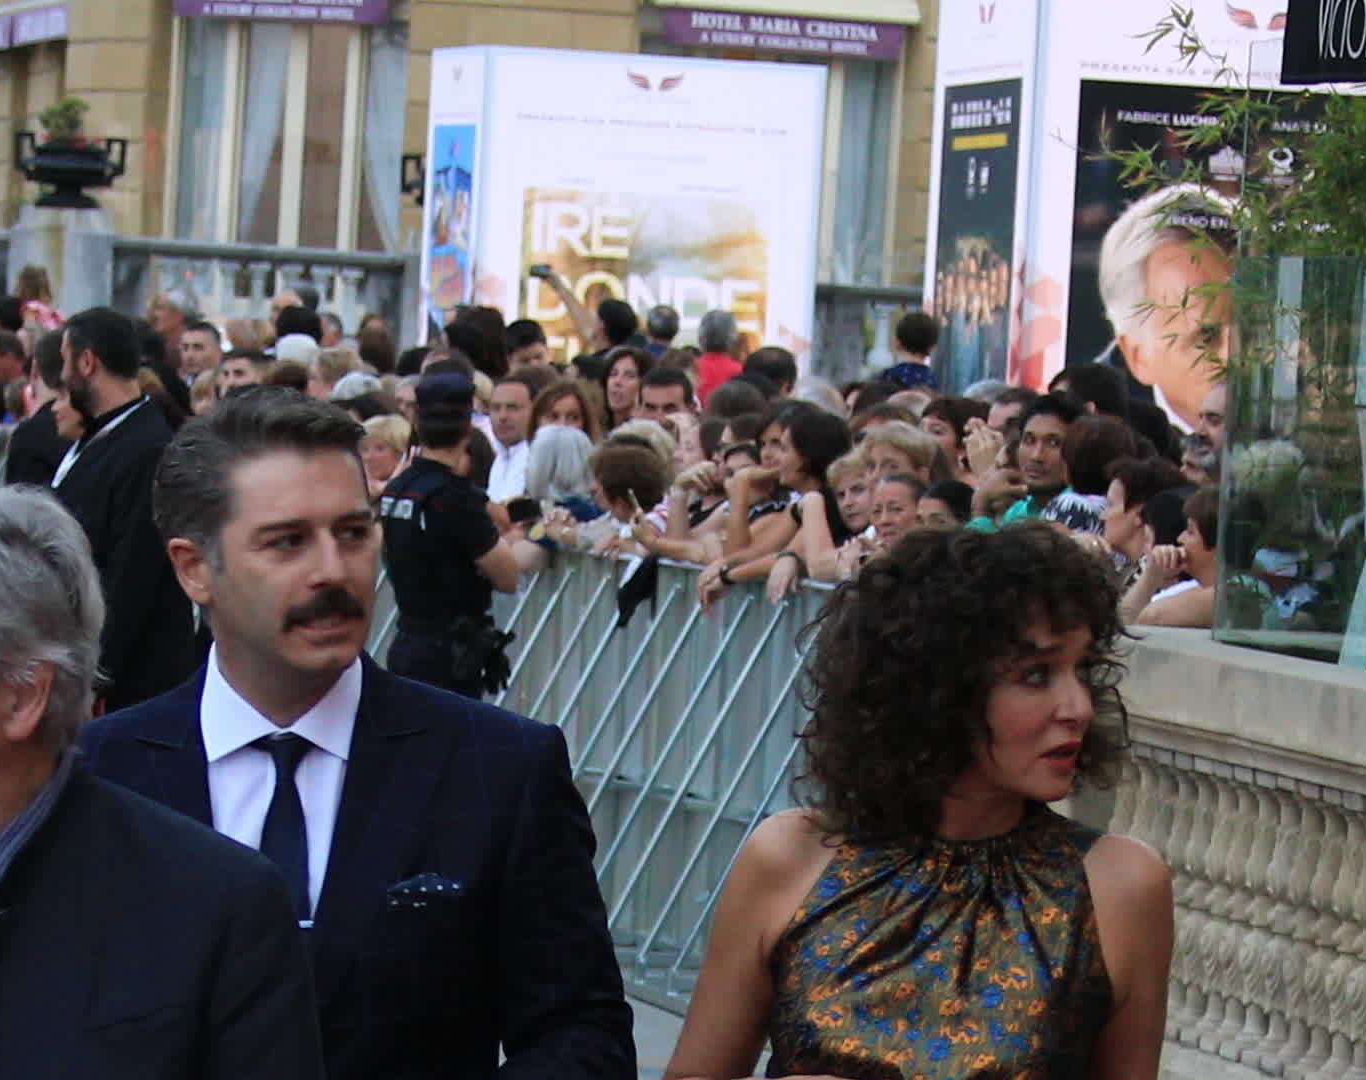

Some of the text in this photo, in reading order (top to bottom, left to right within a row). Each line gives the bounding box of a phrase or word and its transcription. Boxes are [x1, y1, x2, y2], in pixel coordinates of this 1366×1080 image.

[691, 11, 878, 41] HOTEL MARIA CRISTINA
[1116, 110, 1170, 125] FABRICE
[526, 271, 761, 331] DONDE
